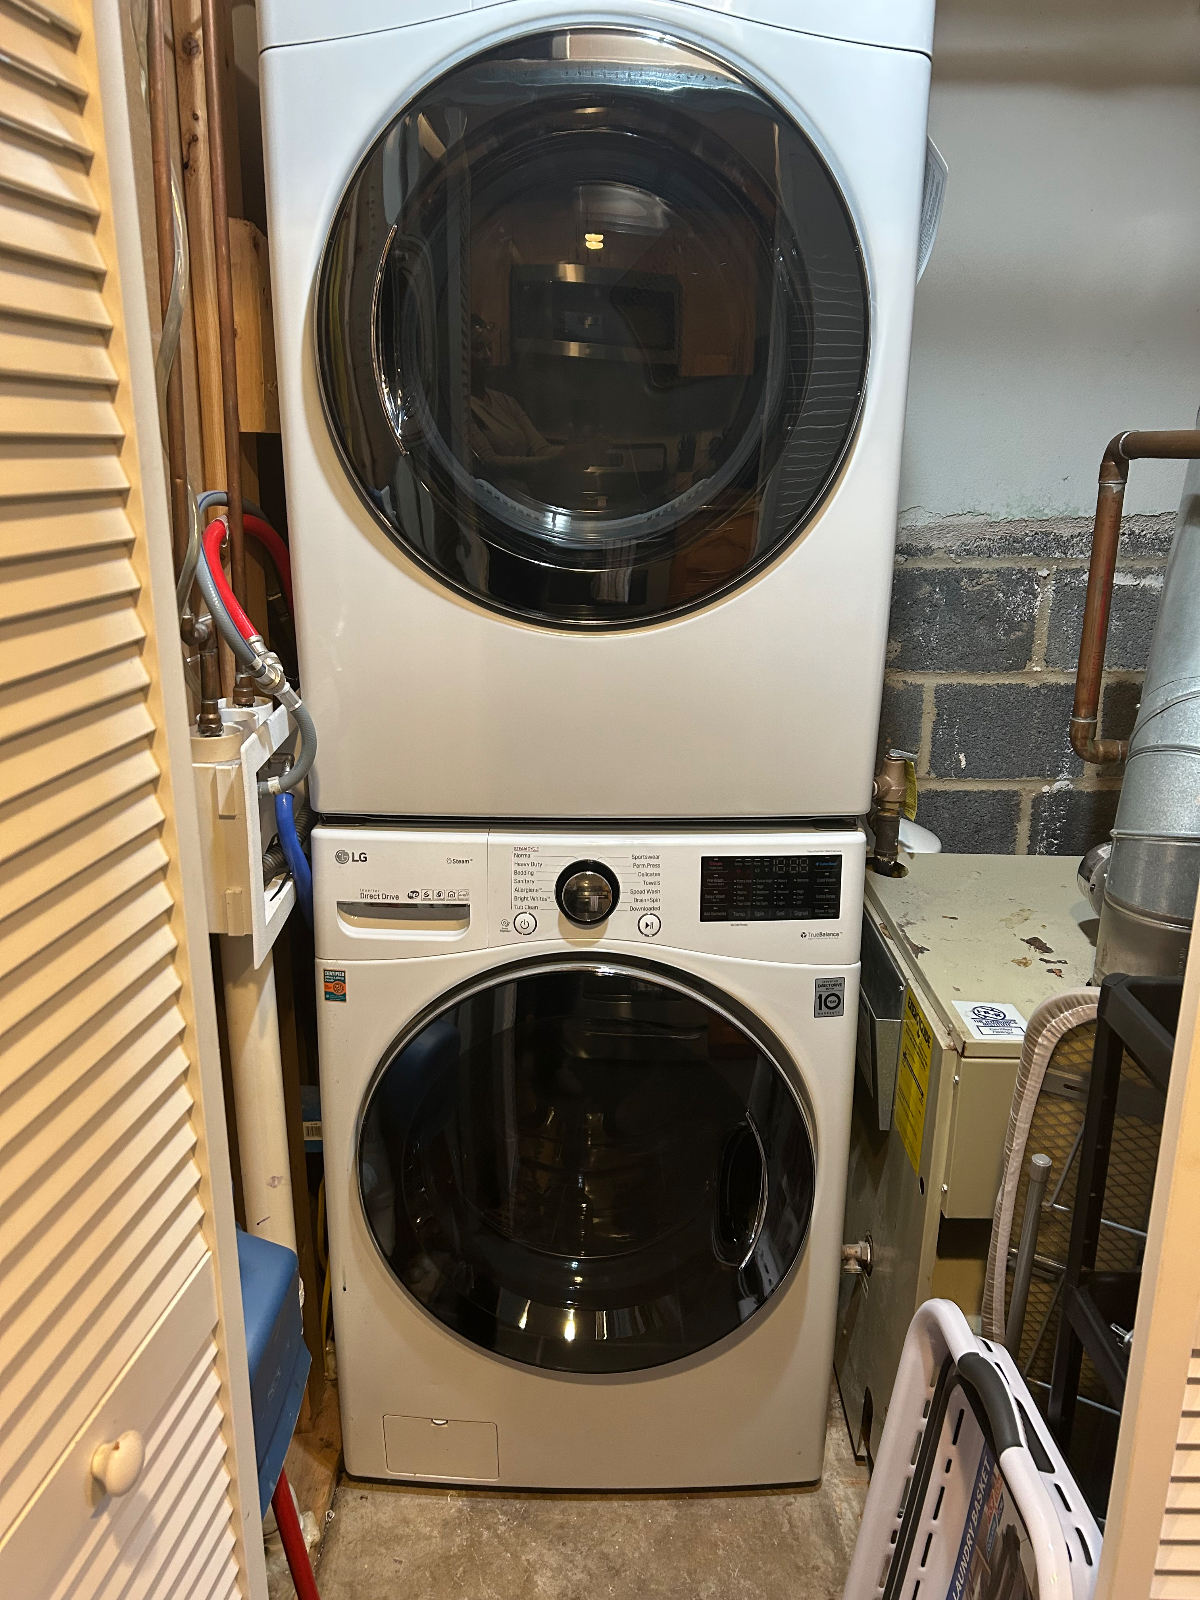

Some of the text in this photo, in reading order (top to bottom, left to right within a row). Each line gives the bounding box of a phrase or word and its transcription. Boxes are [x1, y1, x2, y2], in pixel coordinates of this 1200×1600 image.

[351, 852, 368, 863] LG
[360, 892, 381, 900] Direct
[381, 892, 400, 900] Drive
[817, 993, 842, 1011] 10
[952, 1455, 991, 1600] LAUNDRY BASKET
